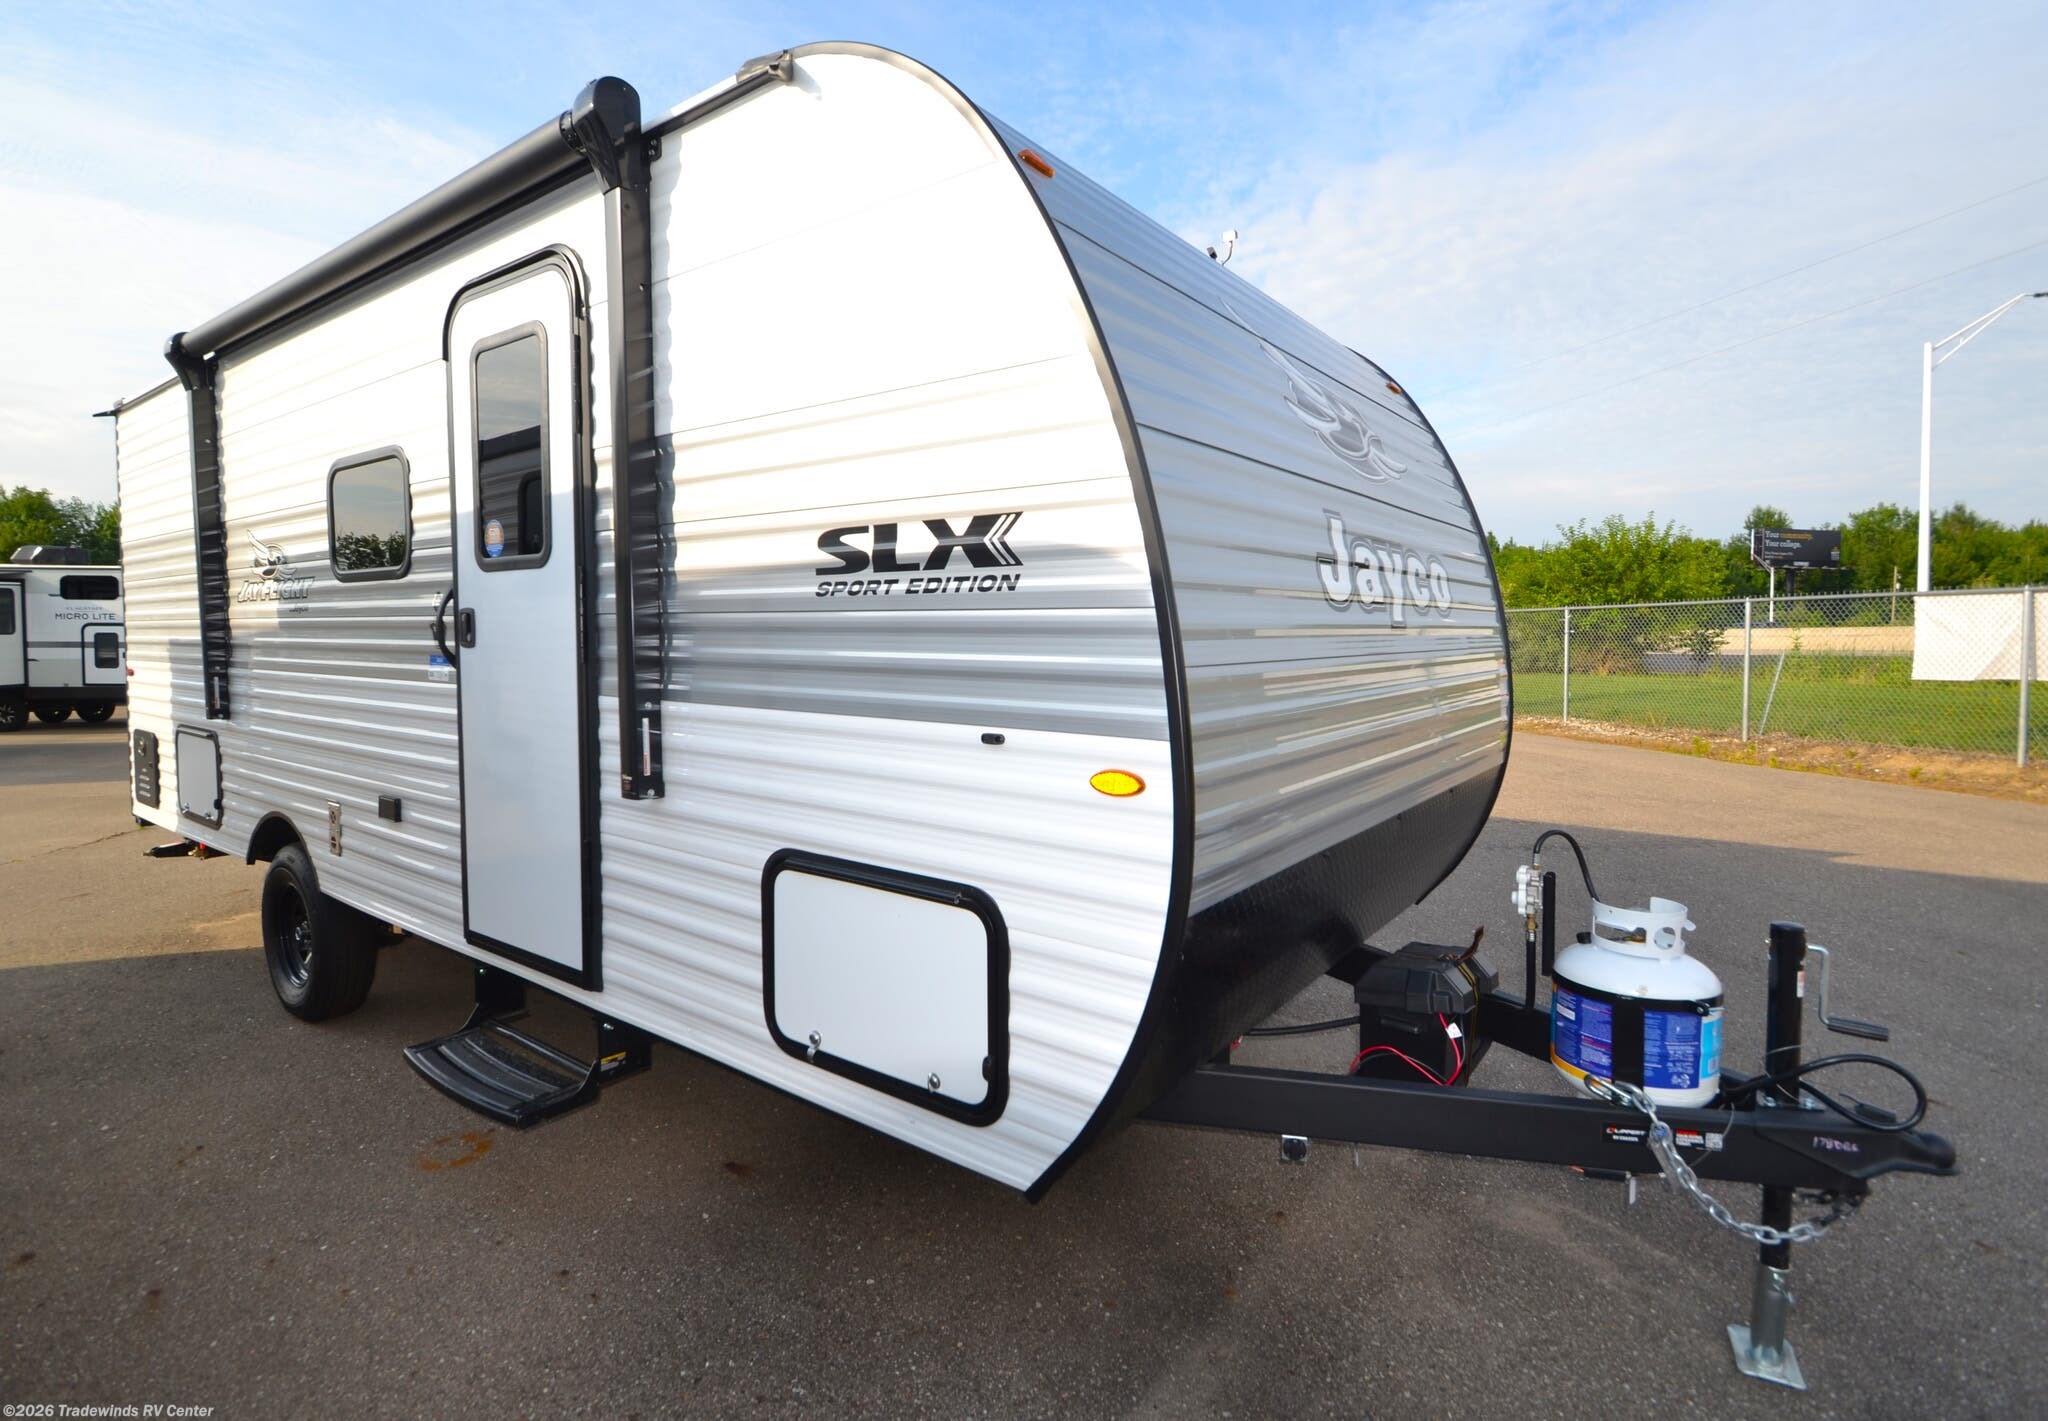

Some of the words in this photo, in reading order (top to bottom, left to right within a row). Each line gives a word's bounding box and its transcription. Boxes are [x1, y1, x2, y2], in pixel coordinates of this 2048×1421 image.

[816, 511, 1023, 575] SLX
[815, 579, 899, 597] SPORT
[905, 574, 1021, 594] EDITION
[1316, 508, 1452, 629] Jayco
[55, 612, 89, 621] MICRO
[93, 613, 117, 621] LITE
